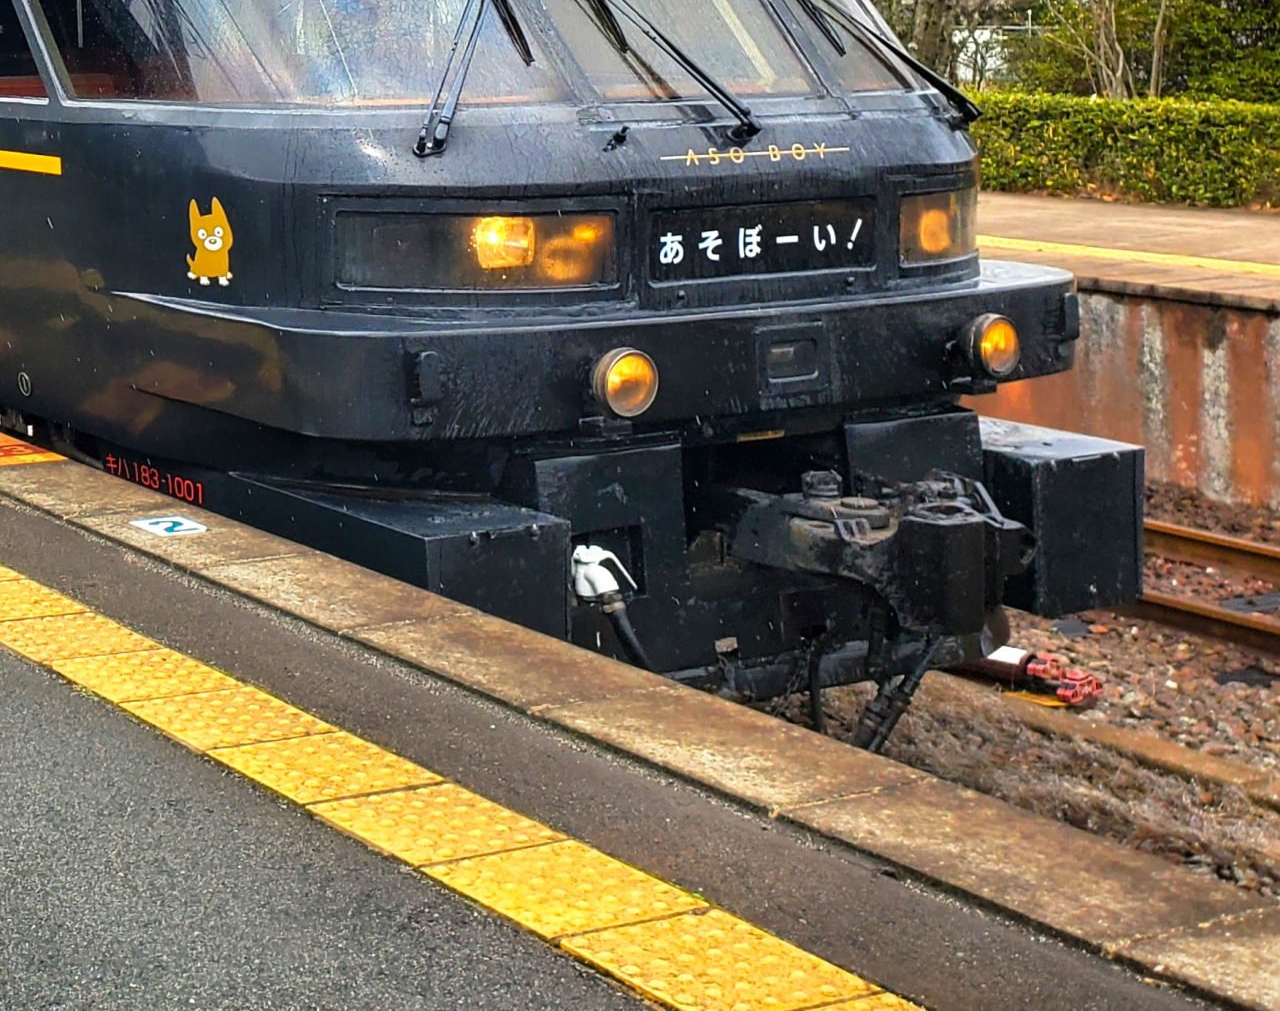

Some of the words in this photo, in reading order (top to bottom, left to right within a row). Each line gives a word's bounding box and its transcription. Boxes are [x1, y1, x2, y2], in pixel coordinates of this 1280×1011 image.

[686, 146, 745, 166] ASO
[768, 142, 826, 162] BOY
[148, 520, 200, 533] 2
